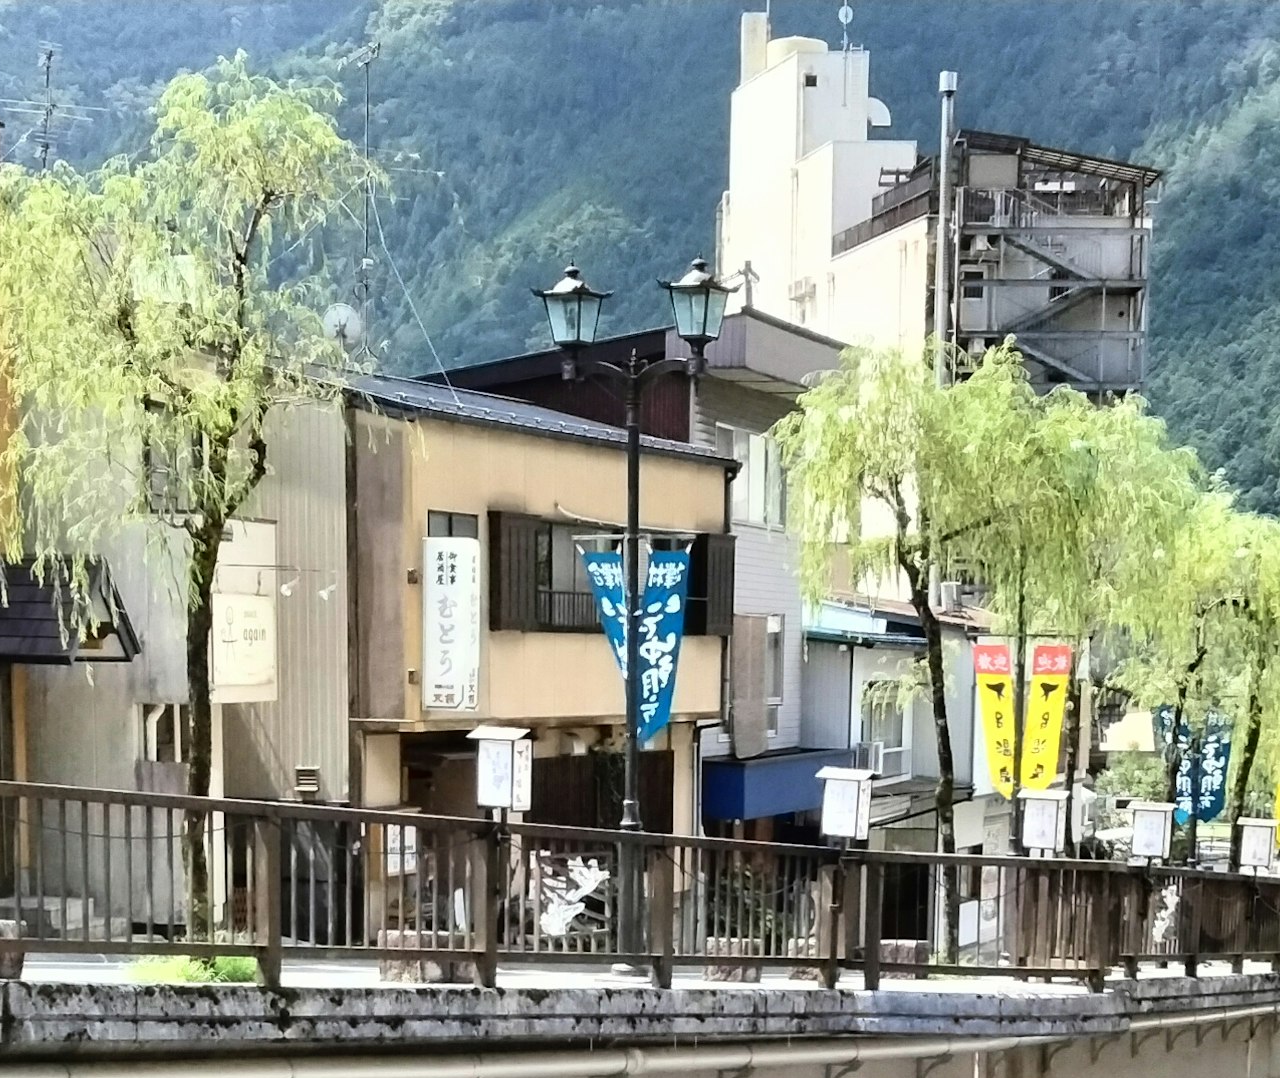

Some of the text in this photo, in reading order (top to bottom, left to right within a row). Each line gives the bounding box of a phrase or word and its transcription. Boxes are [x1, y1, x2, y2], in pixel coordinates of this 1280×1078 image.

[242, 627, 267, 647] again
[437, 593, 458, 677] むとう
